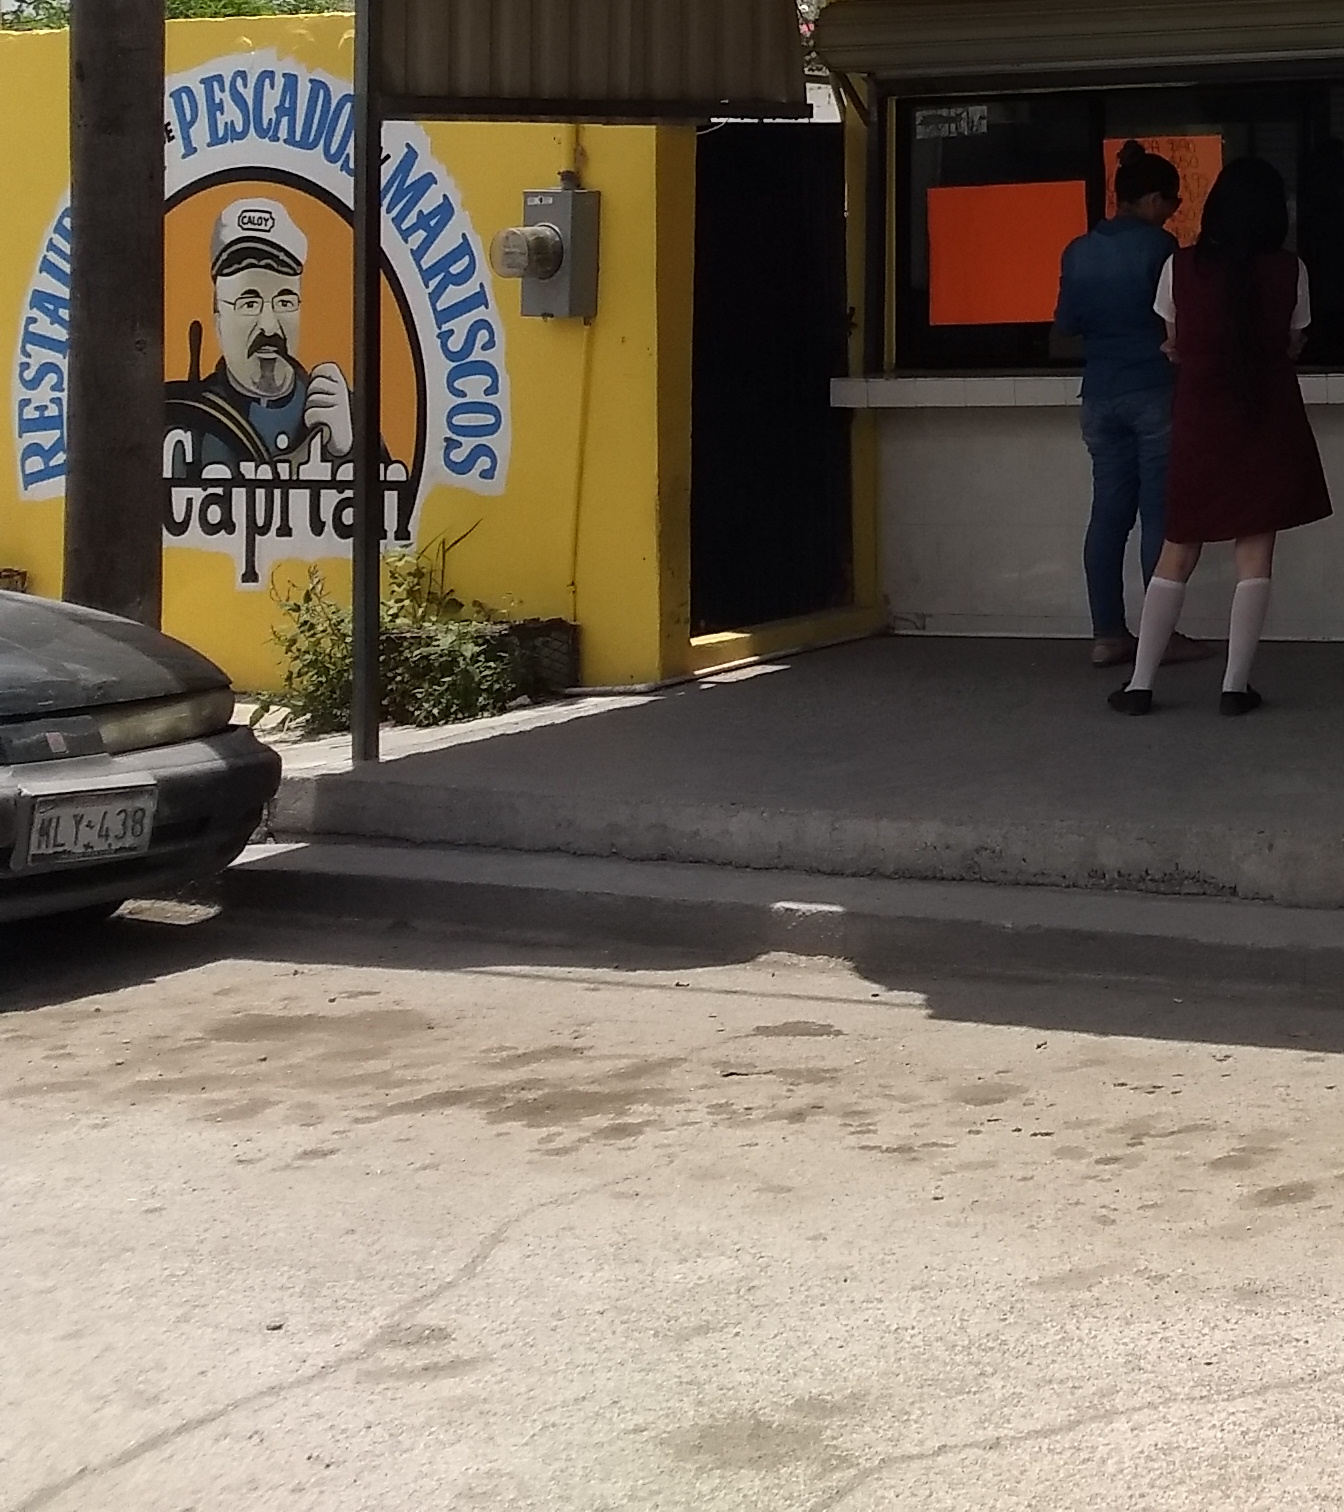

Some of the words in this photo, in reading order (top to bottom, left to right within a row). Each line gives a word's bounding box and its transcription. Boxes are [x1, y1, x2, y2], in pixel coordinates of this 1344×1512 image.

[169, 69, 355, 178] PESCADO
[381, 141, 503, 482] MARISCOS
[241, 215, 270, 228] CALOY
